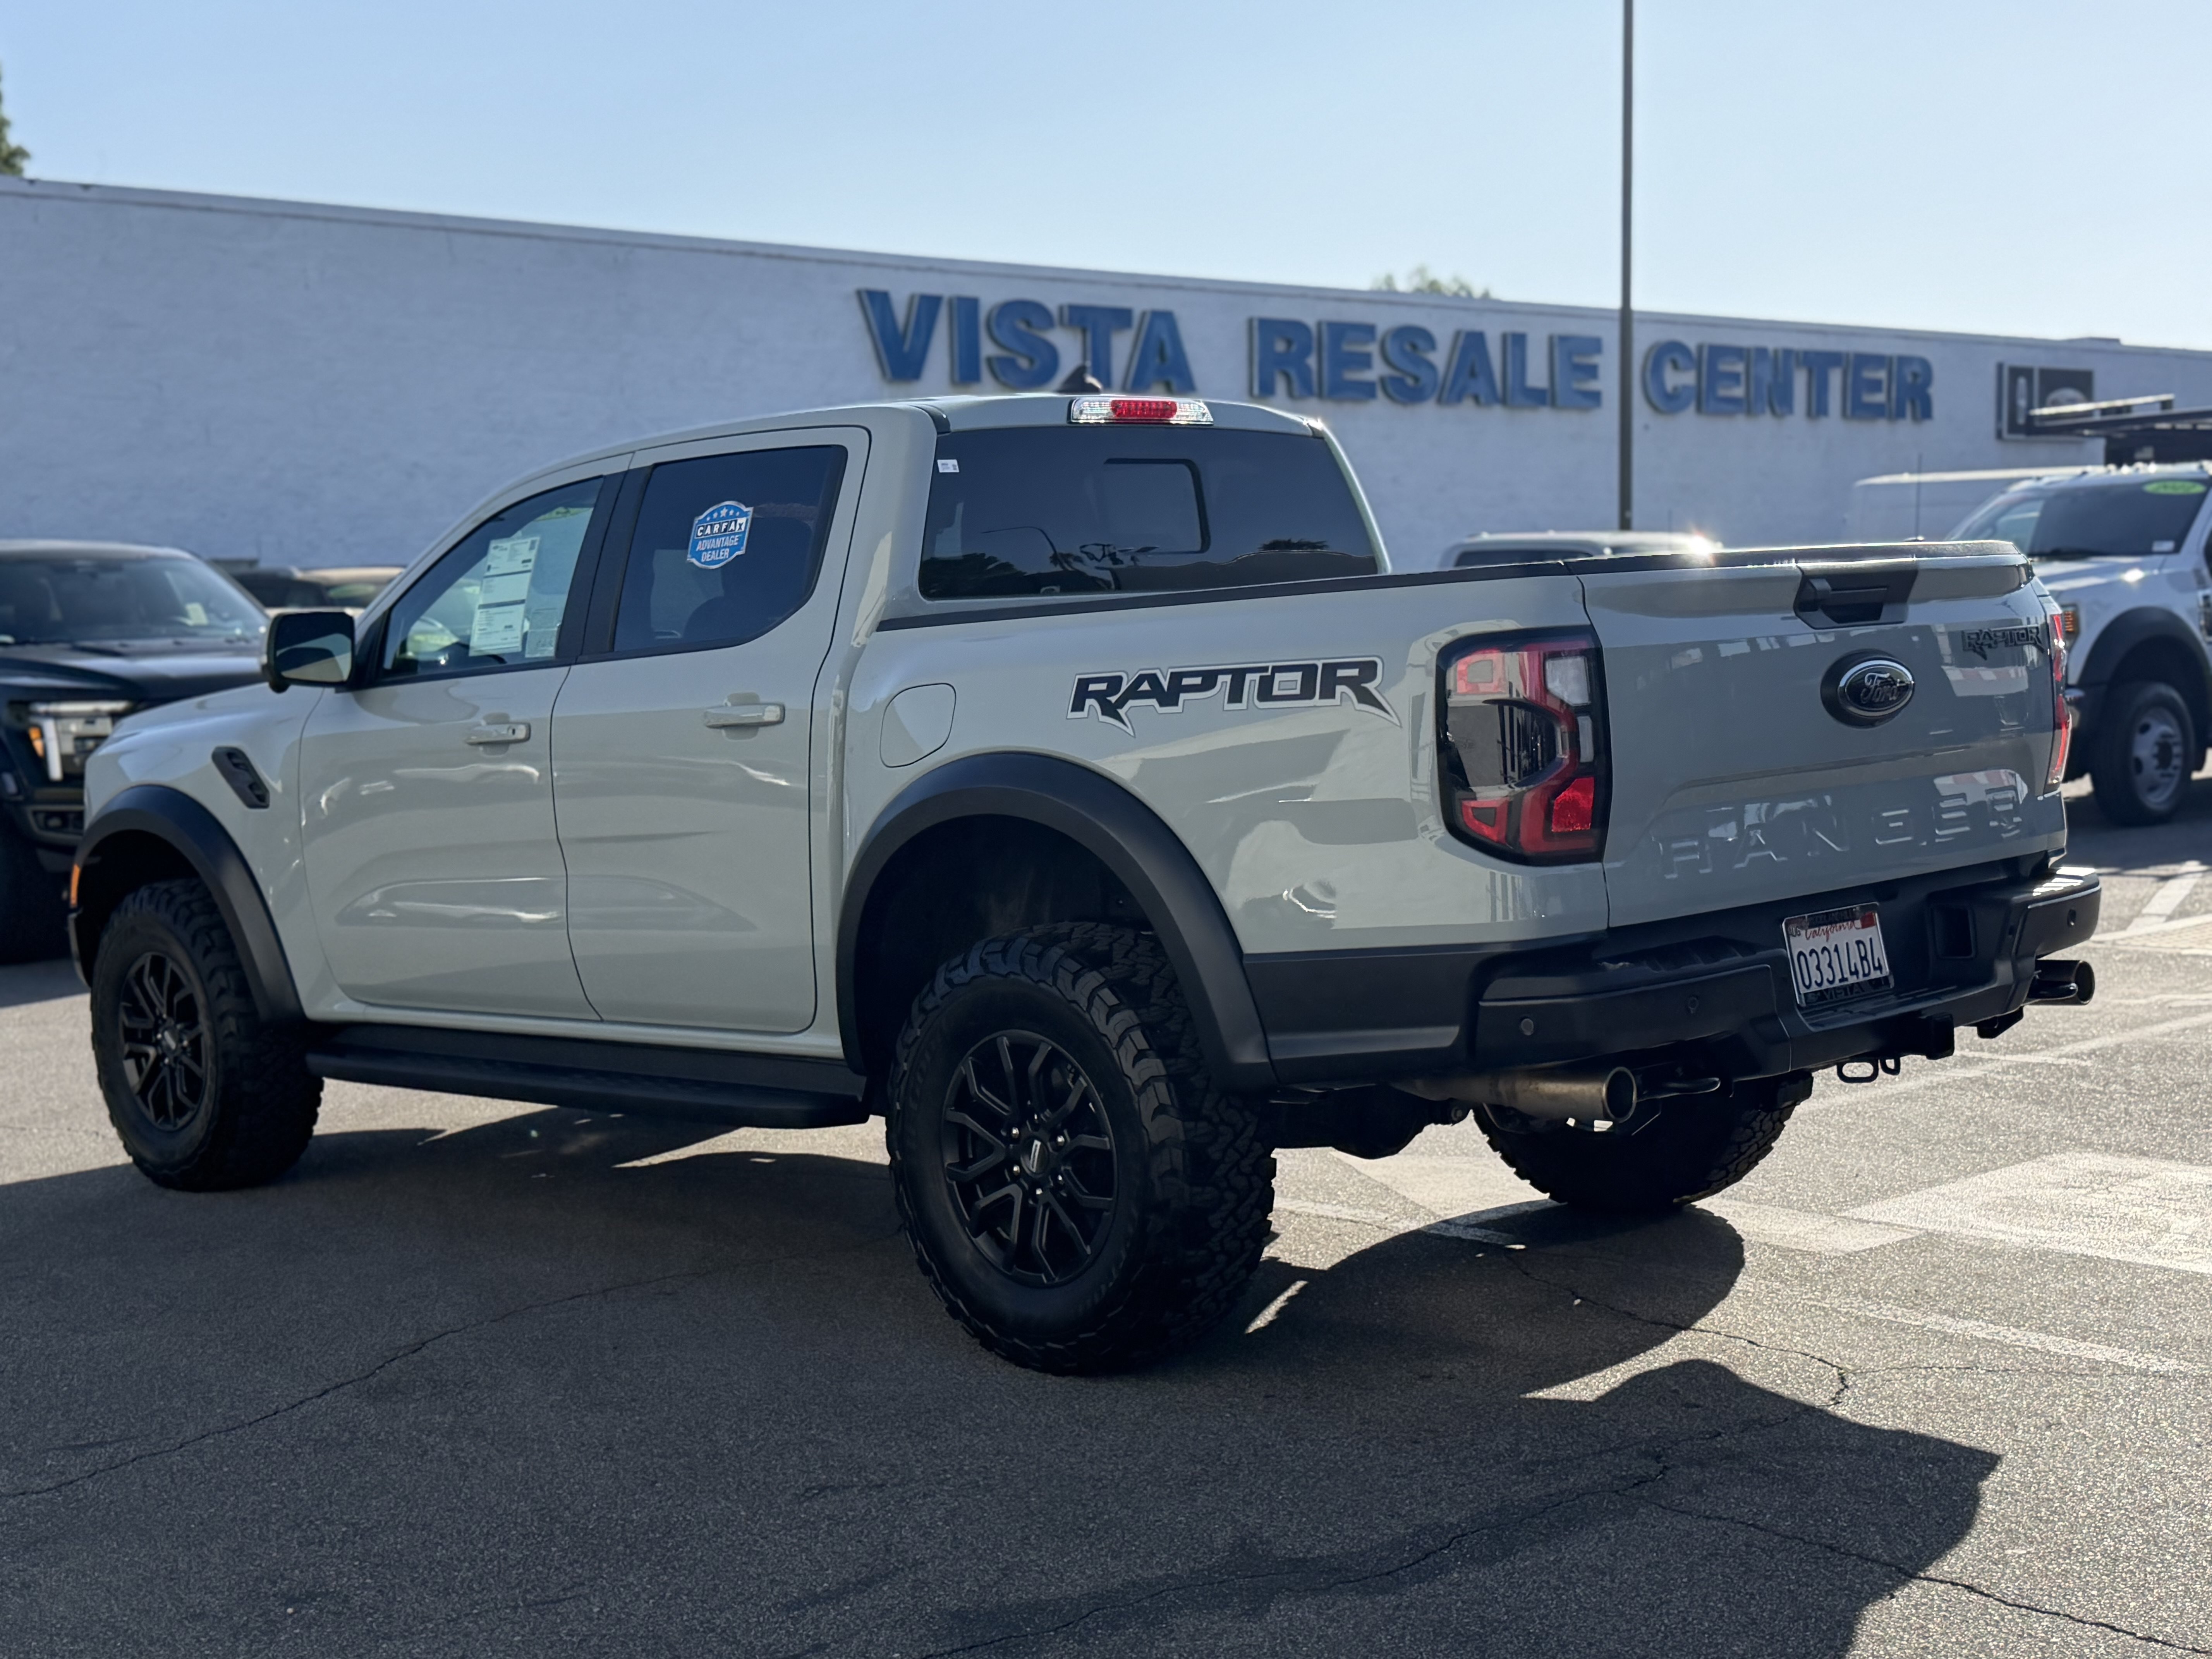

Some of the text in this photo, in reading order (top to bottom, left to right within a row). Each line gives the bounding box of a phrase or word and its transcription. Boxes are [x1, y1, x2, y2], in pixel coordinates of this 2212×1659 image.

[857, 289, 1932, 421] VISTA RESALE CENTER
[696, 534, 739, 551] ADVANTAGE
[697, 519, 745, 537] CARFAX
[701, 548, 730, 562] DEALER
[1961, 628, 2045, 661] RAPTOR
[1067, 655, 1402, 738] RAPTOR
[1860, 672, 1899, 704] Ford
[1797, 937, 1883, 990] 03314B4
